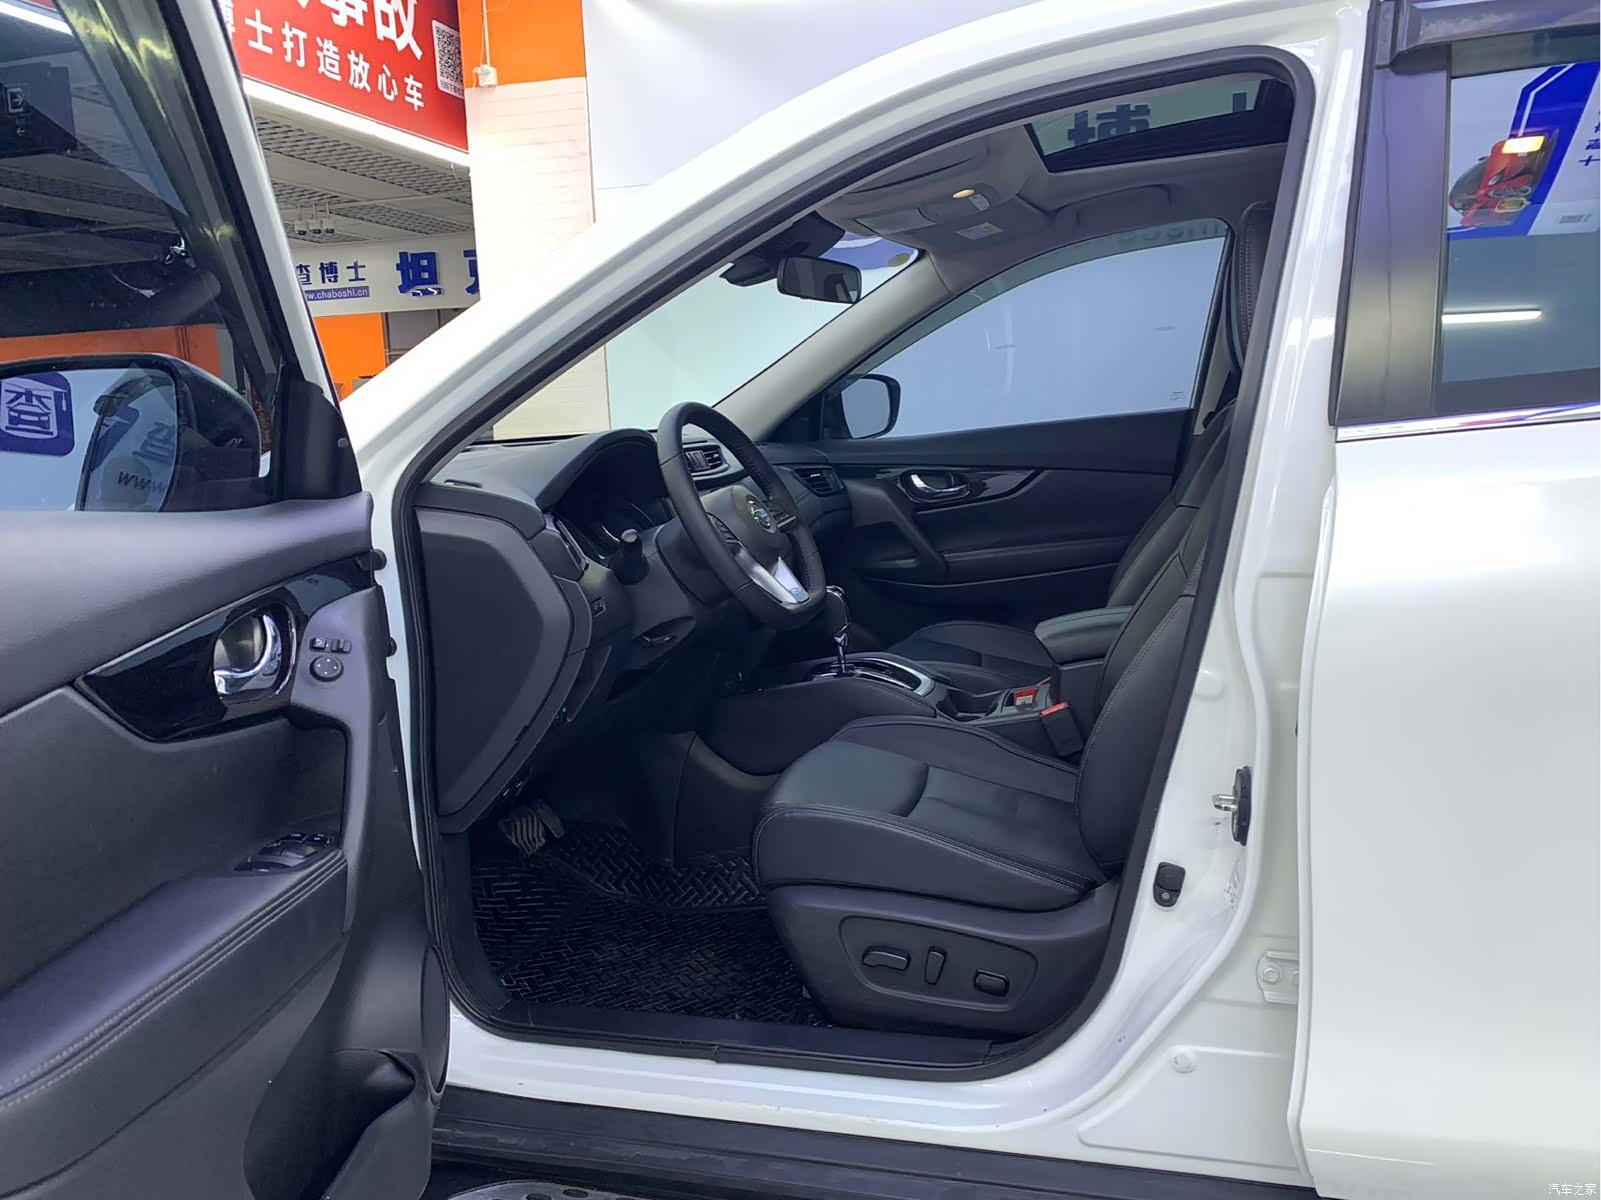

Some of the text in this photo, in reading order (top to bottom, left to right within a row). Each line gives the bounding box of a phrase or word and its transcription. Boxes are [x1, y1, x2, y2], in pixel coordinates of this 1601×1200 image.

[297, 259, 367, 286] 查博士
[306, 289, 369, 300] w.chaboshi.cn
